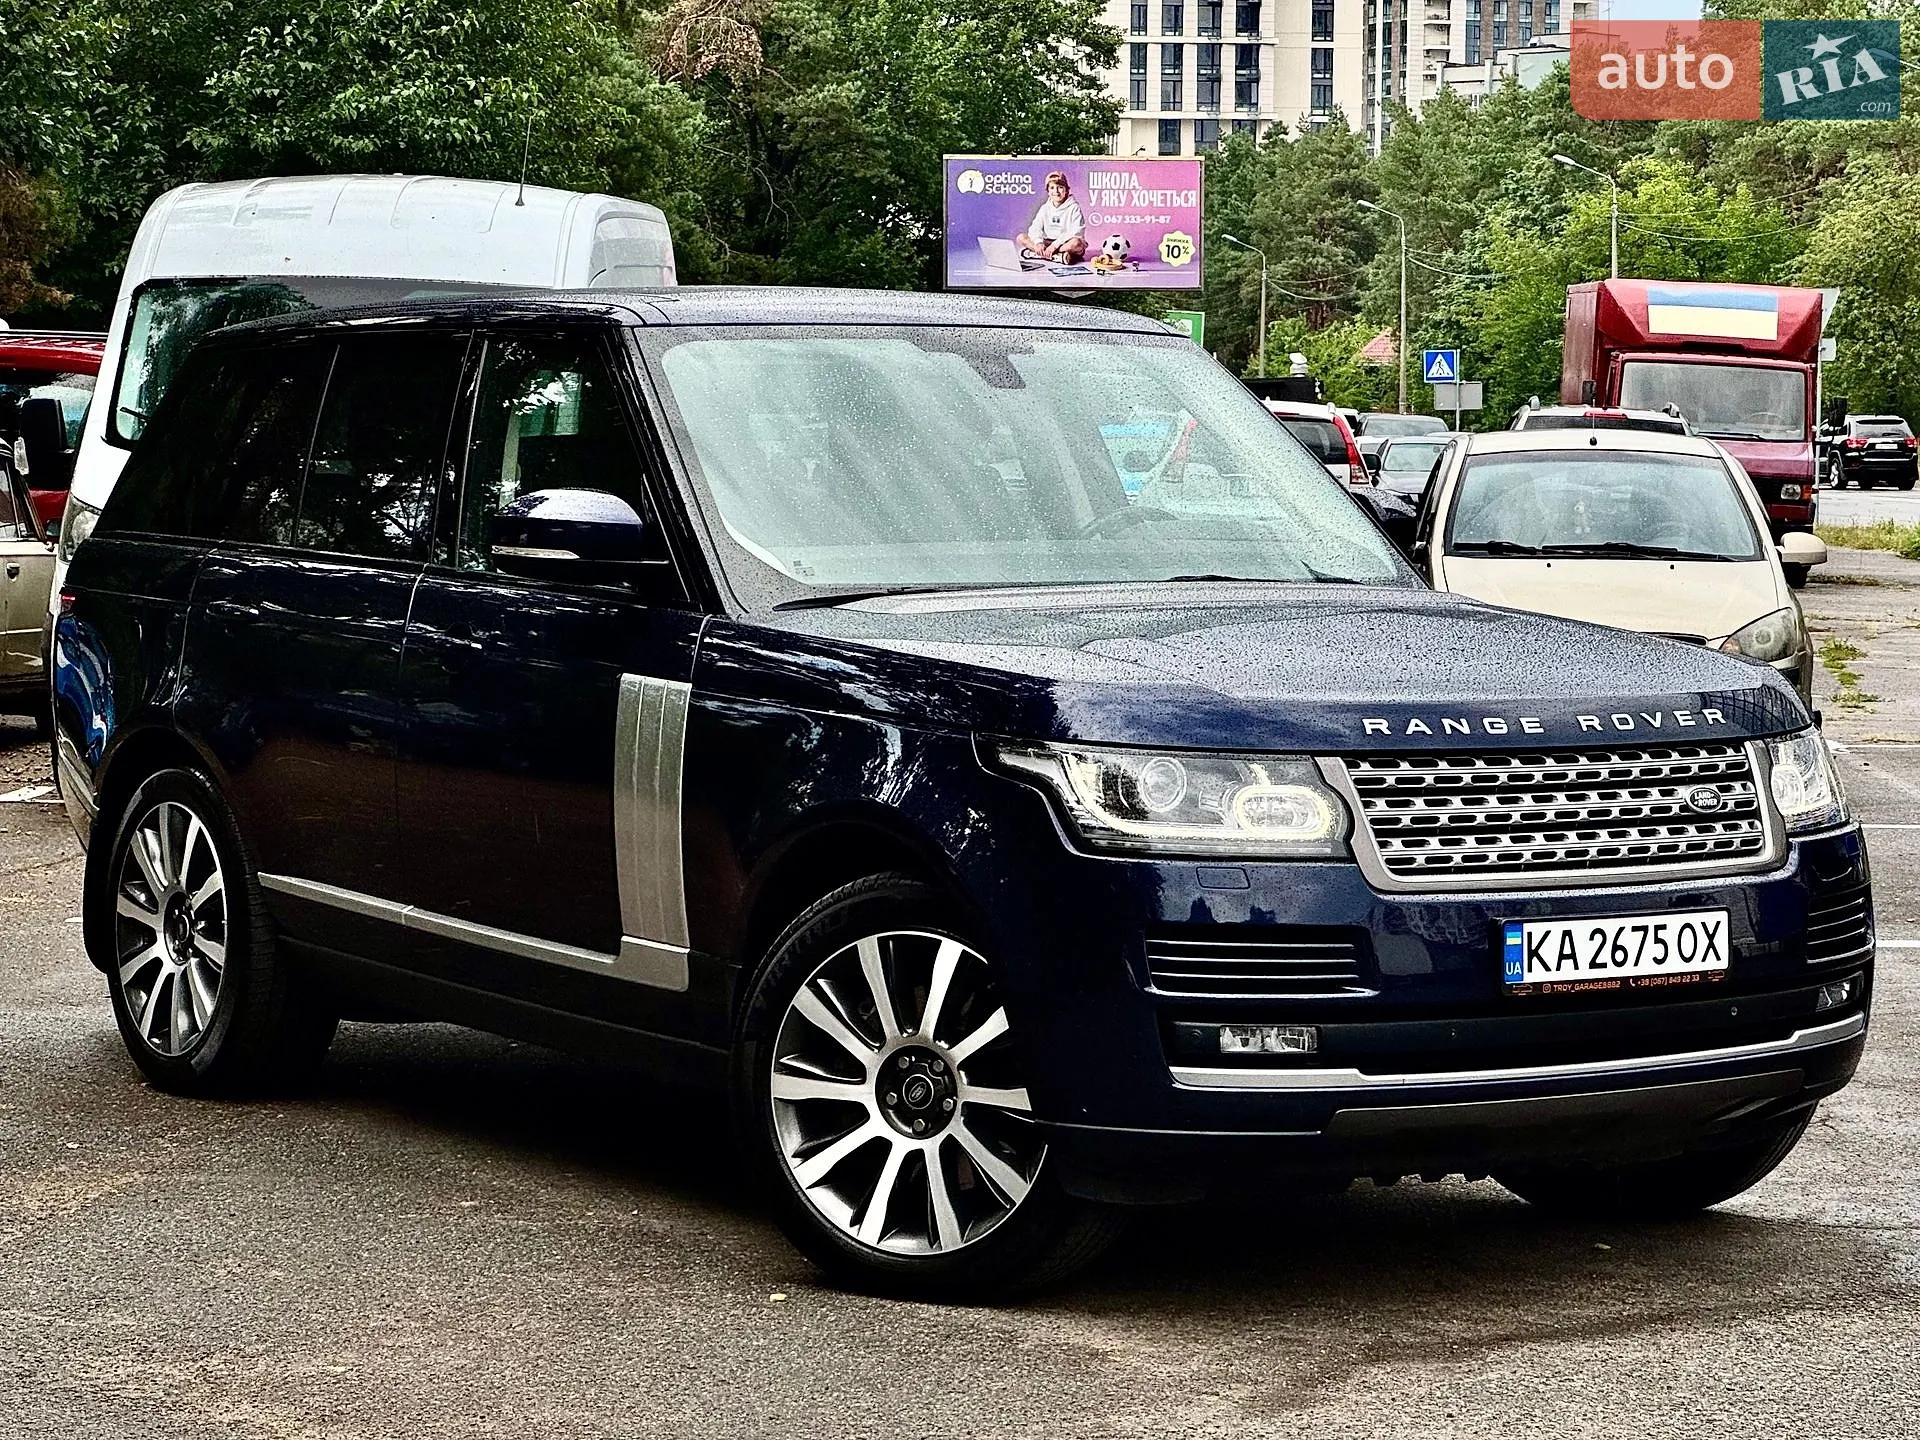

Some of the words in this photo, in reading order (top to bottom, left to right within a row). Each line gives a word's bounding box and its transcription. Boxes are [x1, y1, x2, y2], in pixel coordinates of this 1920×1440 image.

[984, 172, 1032, 185] optima
[1089, 171, 1143, 190] ШКОЛА,
[984, 184, 1036, 195] SCHOOL
[1089, 189, 1099, 207] У
[1101, 189, 1128, 207] ЯКУ
[1131, 189, 1197, 208] ХОЧЕТЬСЯ
[1103, 215, 1121, 224] 067
[1124, 215, 1172, 224] 333-91-87
[1361, 717, 1545, 735] RANGE
[1575, 708, 1727, 732] ROVER
[1694, 791, 1711, 800] LAND
[1697, 798, 1718, 807] ROVER
[1526, 929, 1580, 973] KA
[1588, 924, 1669, 970] 2675
[1676, 920, 1722, 964] OX
[1505, 961, 1522, 976] UA
